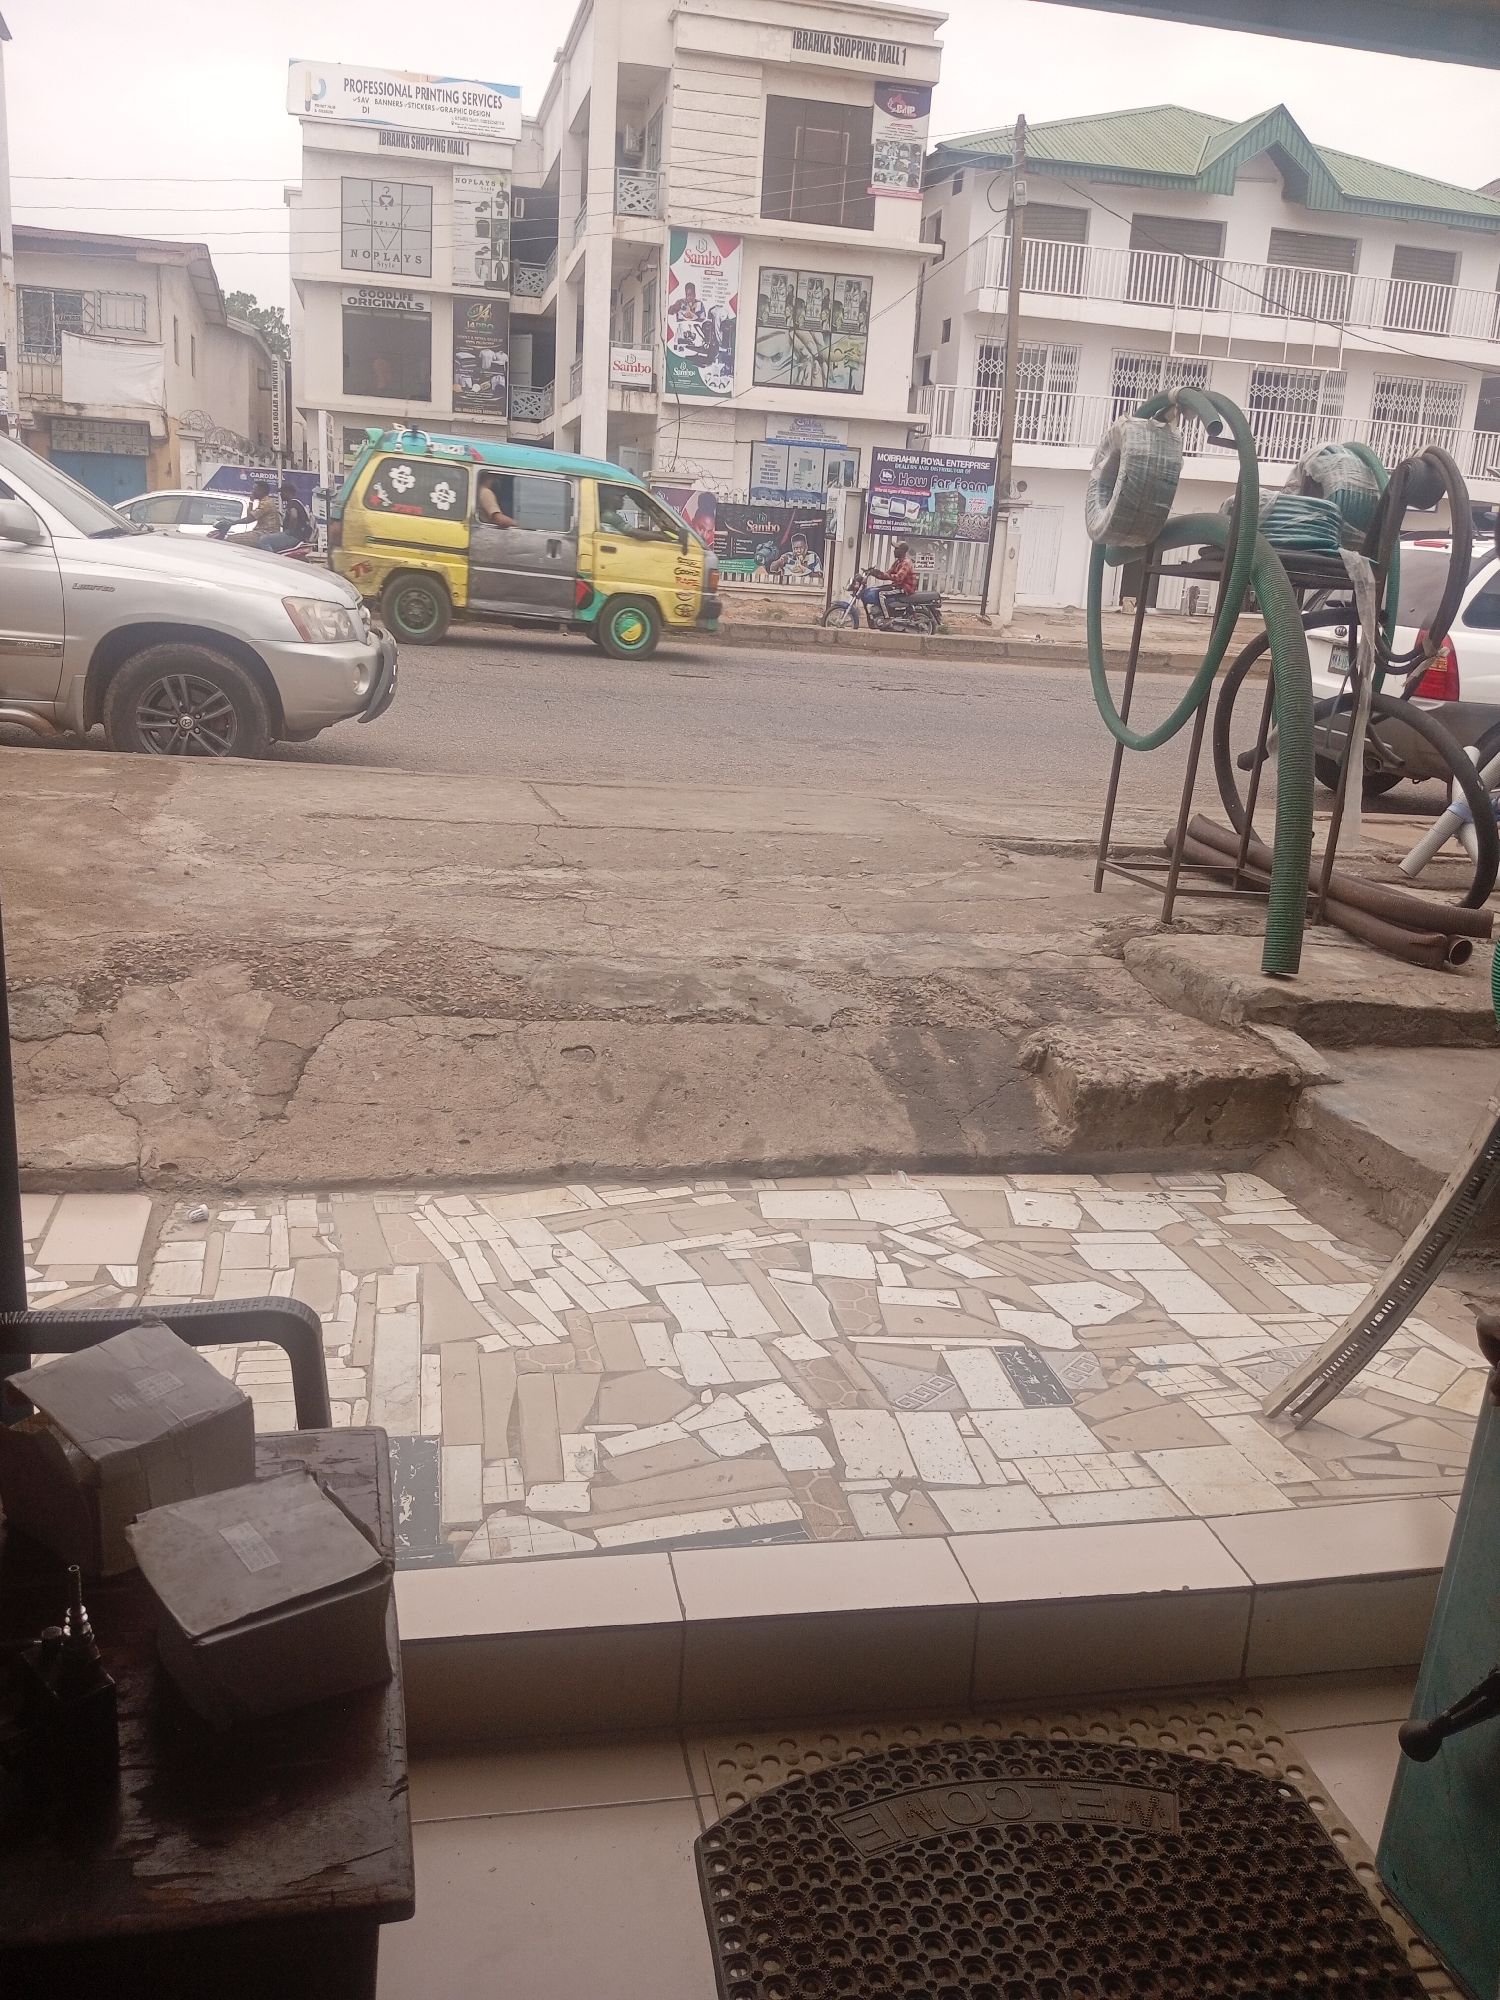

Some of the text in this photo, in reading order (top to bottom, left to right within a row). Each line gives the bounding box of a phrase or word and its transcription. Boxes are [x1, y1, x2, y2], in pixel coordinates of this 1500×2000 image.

[792, 30, 907, 66] IBRAHKA SHOPPING MALL 1
[343, 77, 503, 109] PROFESSIONAL PRINTING SERVICES
[374, 98, 403, 108] BANNERS
[407, 102, 435, 111] STICKERS
[440, 106, 467, 115] GRAPHIC
[468, 109, 491, 118] DESIGN
[379, 130, 470, 156] IBRAHKA SHOPPING MALL 1
[454, 177, 496, 187] NOPLAYS
[350, 249, 422, 264] NOPLAYS
[683, 248, 722, 266] Sambo
[377, 261, 396, 269] Style
[358, 289, 414, 301] GOODLIFE
[347, 297, 425, 310] ORIGINALS
[612, 360, 652, 374] Sambo
[920, 457, 945, 466] ROYAL
[946, 459, 991, 470] ENTERPRISE
[250, 472, 285, 480] CARDINL
[898, 472, 928, 488] How
[746, 520, 780, 533] Sambo
[841, 1783, 1175, 1850] WELCOME
